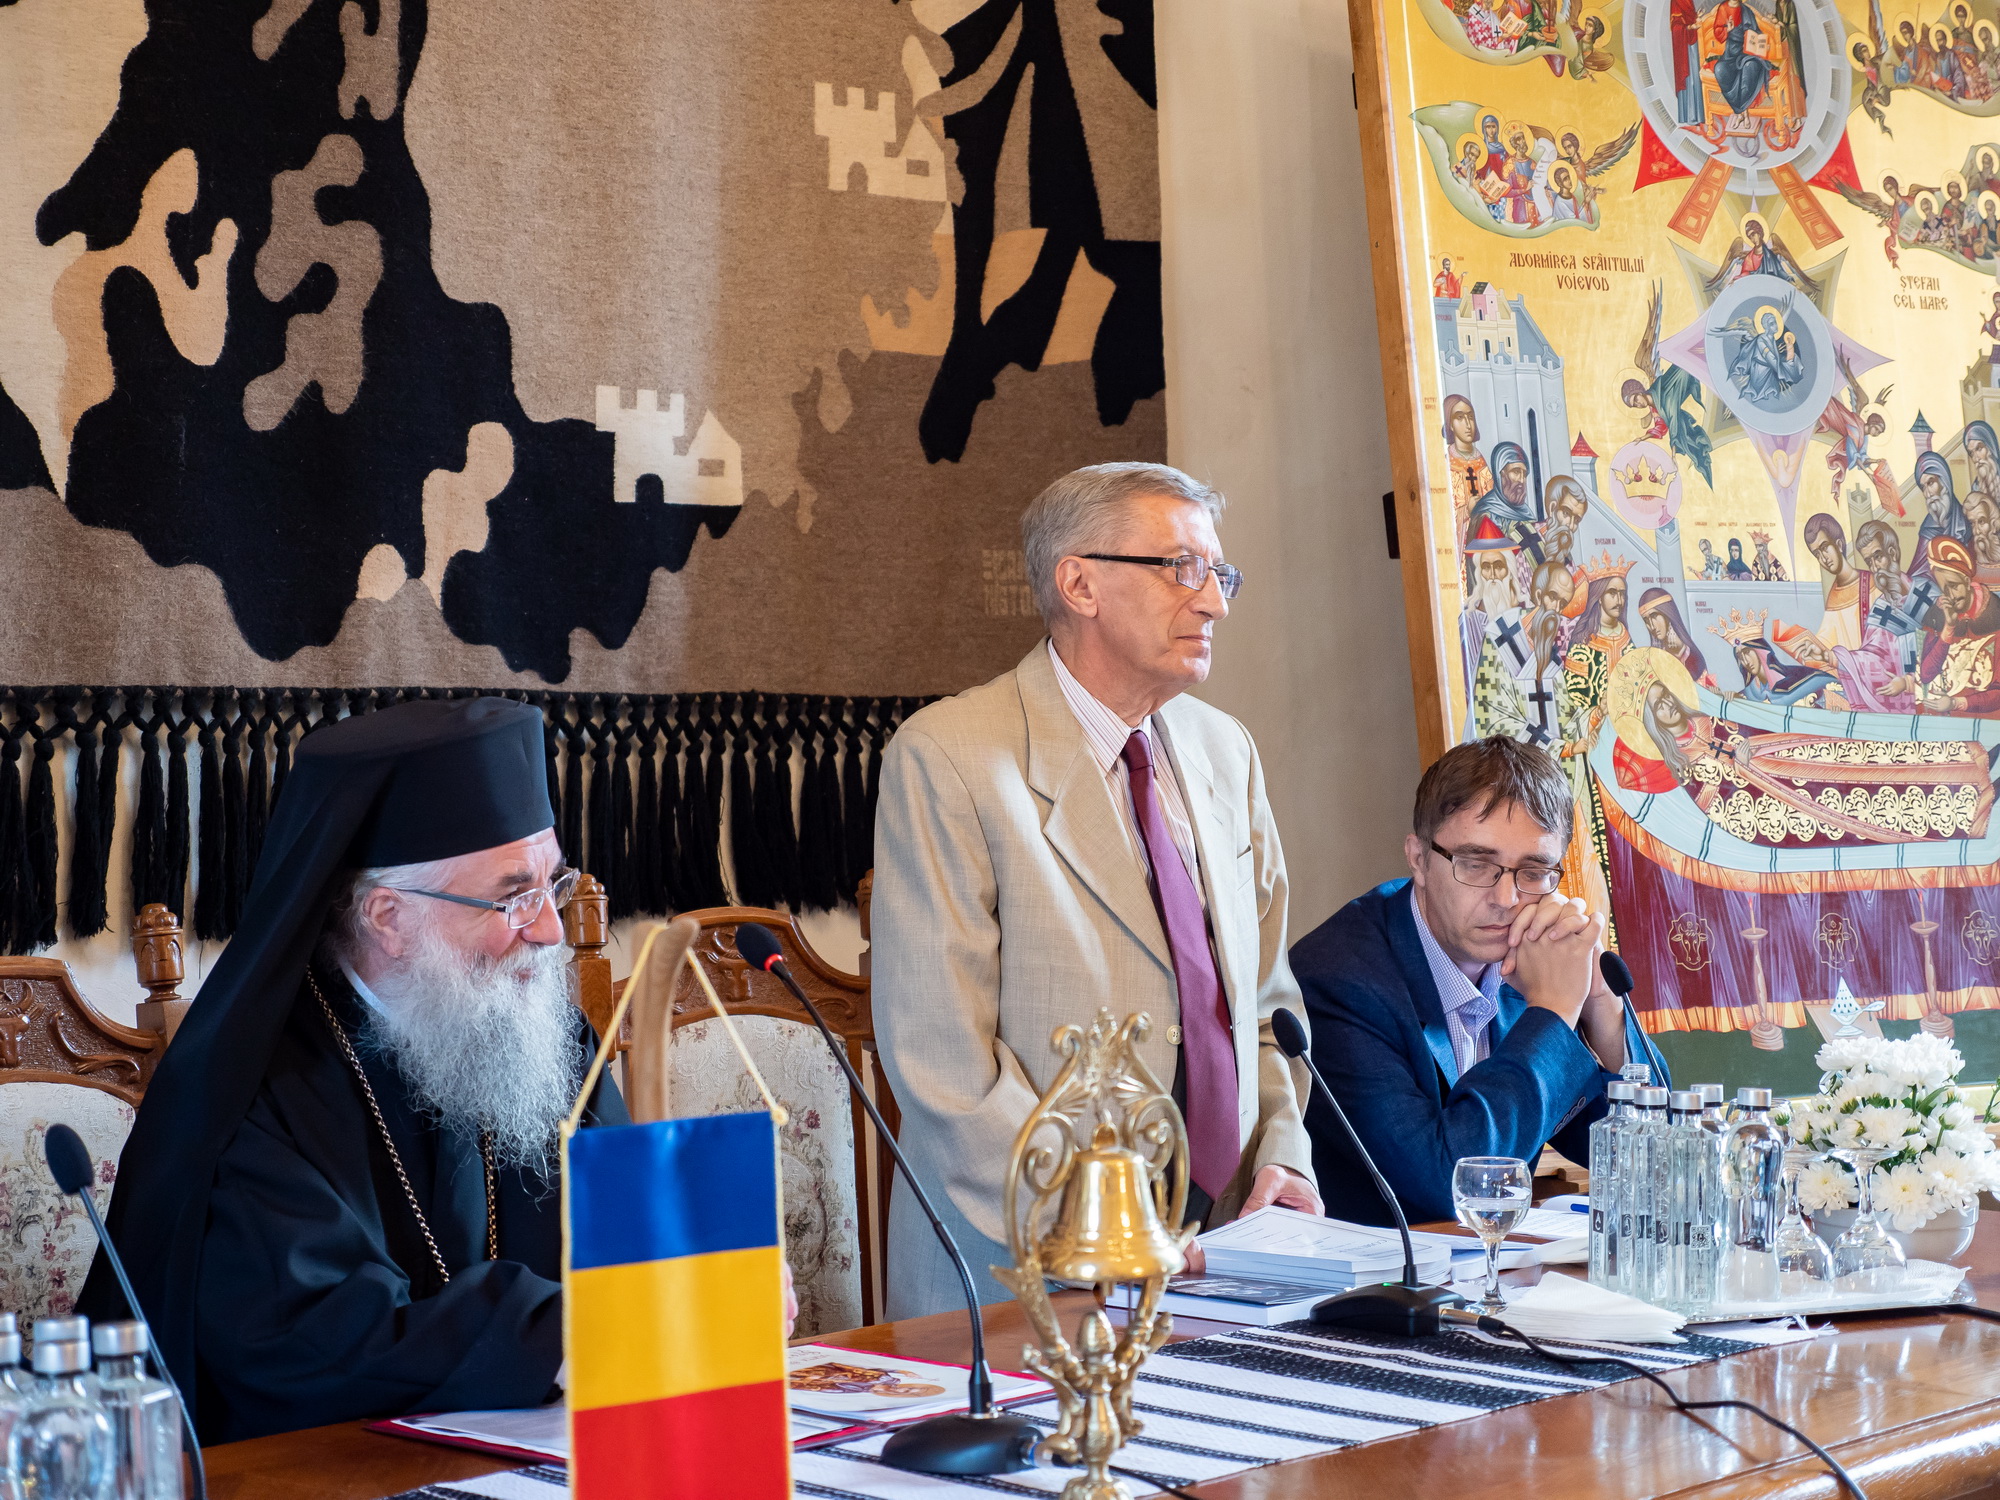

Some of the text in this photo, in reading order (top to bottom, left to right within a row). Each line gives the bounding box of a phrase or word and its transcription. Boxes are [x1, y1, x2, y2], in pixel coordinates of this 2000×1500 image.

[1556, 272, 1610, 291] VOIEVOD
[1893, 294, 1948, 310] CEL MARE
